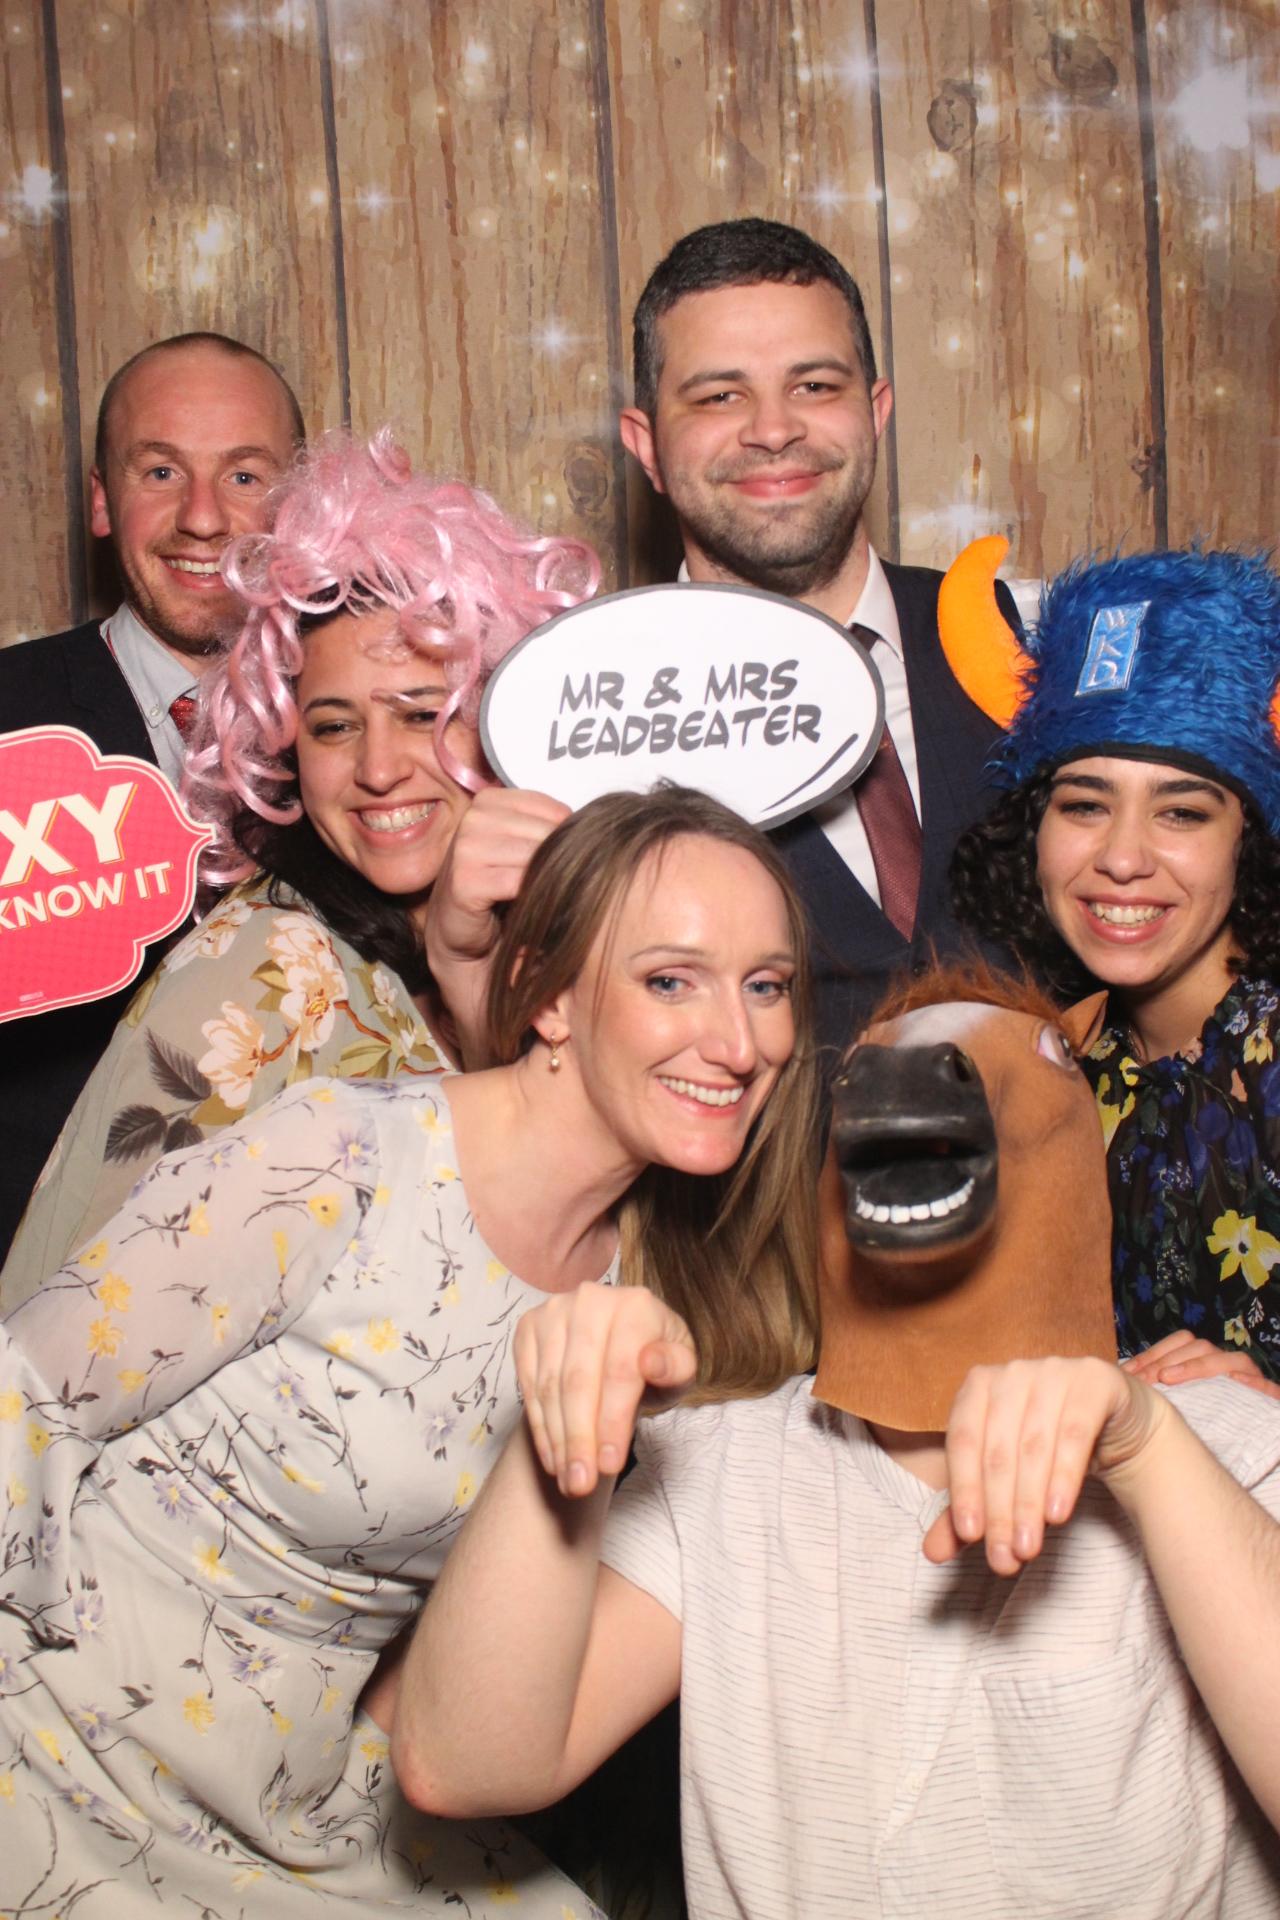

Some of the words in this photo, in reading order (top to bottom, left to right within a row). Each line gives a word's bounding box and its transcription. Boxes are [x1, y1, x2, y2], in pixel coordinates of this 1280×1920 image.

[558, 671, 625, 714] MR
[643, 666, 683, 708] &
[704, 659, 800, 704] MRS
[547, 704, 823, 761] LEADBEATER
[134, 862, 173, 898] IT
